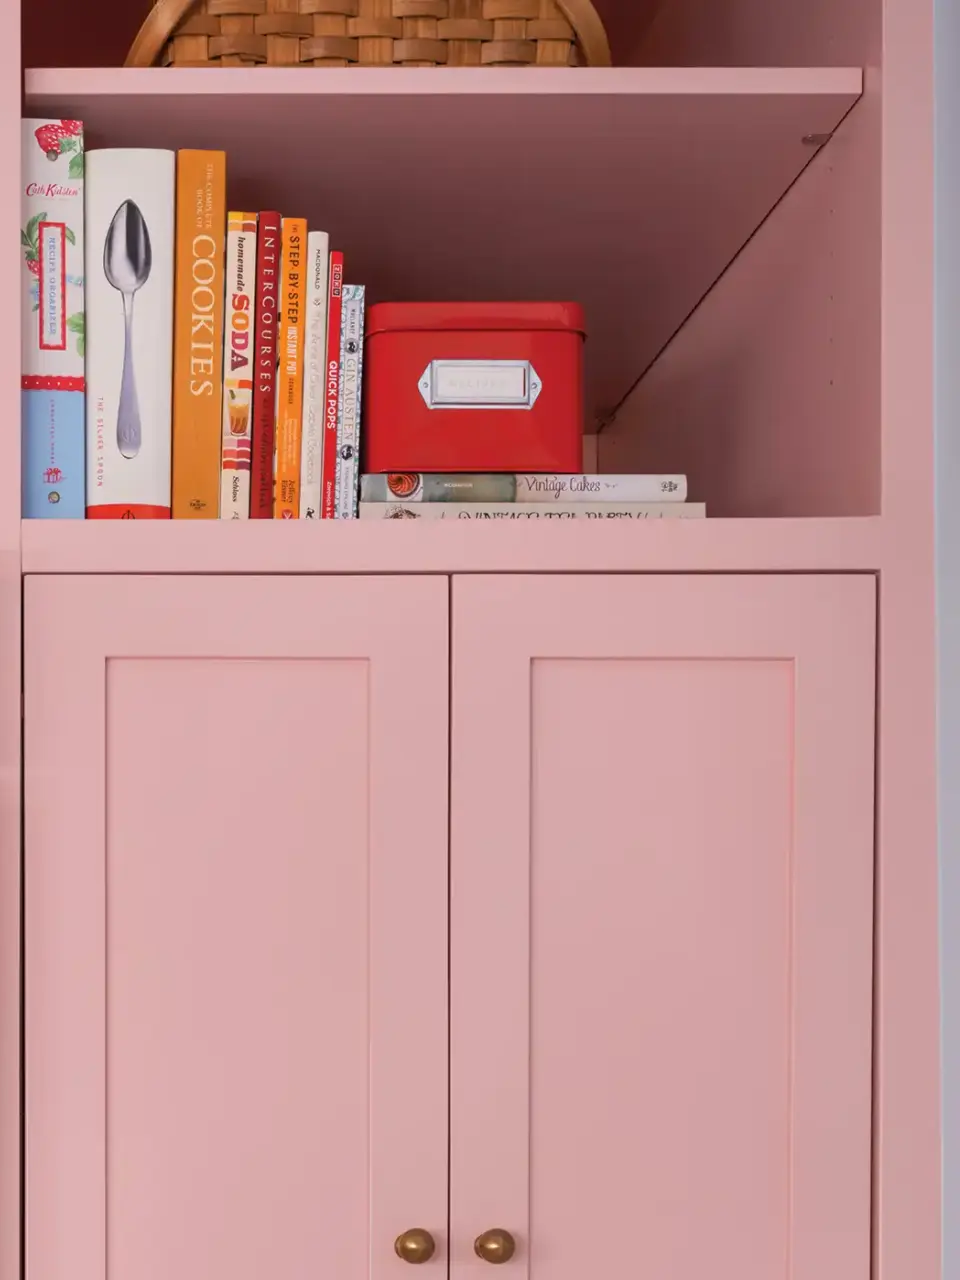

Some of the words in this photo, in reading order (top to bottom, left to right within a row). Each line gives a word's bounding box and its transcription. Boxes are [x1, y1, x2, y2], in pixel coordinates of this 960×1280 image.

[48, 236, 57, 273] RECIPE
[236, 236, 246, 291] homemade
[190, 234, 217, 397] COOKIES
[230, 293, 250, 372] SODA
[286, 326, 298, 359] INSTANT
[286, 360, 297, 375] POT
[328, 360, 338, 397] QUICK
[346, 358, 356, 382] GIN
[327, 399, 337, 429] POPS
[344, 387, 355, 441] AUSTEN
[232, 475, 240, 503] Schloss
[524, 476, 567, 499] Vintage
[569, 475, 601, 493] Cakes
